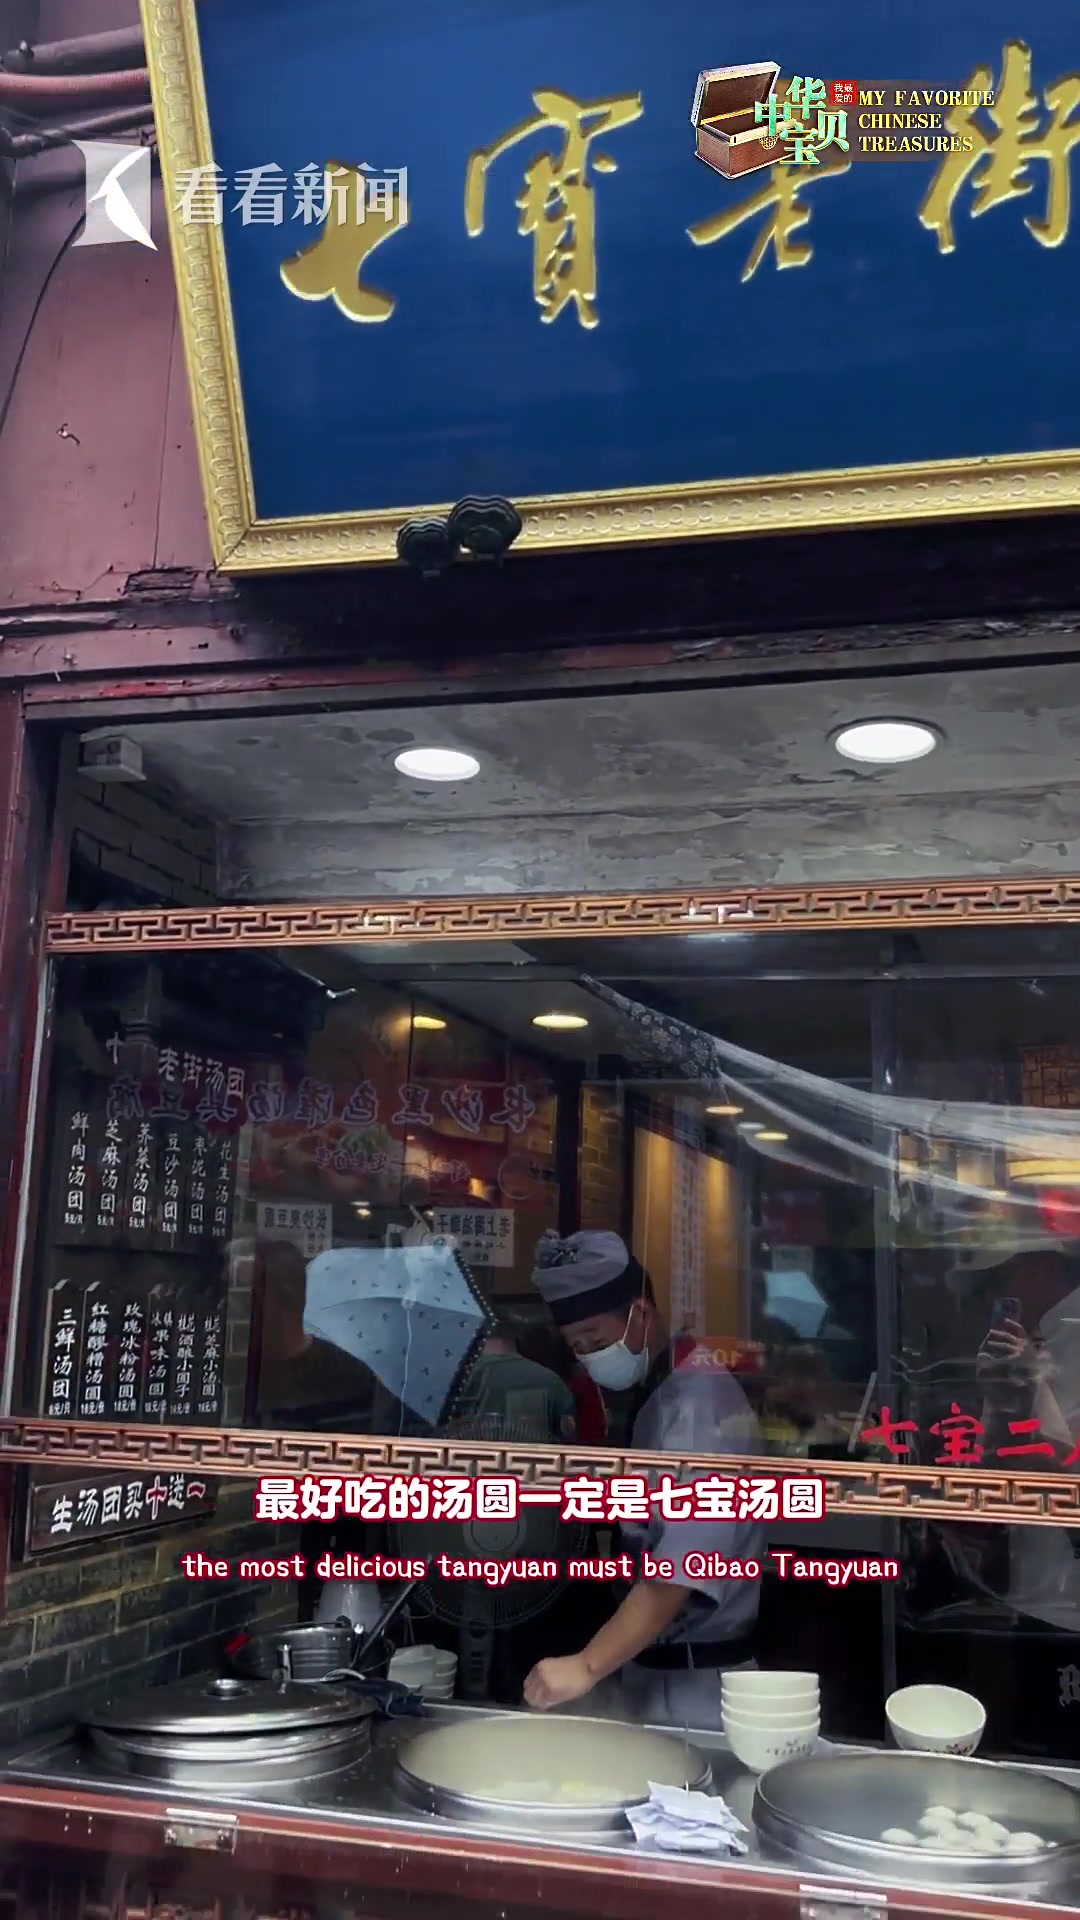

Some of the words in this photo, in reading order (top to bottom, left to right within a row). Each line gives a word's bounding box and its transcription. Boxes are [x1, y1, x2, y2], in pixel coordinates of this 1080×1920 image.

[67, 1111, 90, 1211] 鲜肉汤团
[99, 1119, 123, 1213] 芝麻汤团
[163, 1132, 182, 1221] 豆沙汤团
[214, 1140, 233, 1225] 花生汤团
[52, 1307, 78, 1399] 三鲜汤团
[50, 1473, 206, 1534] 生汤团买十送一
